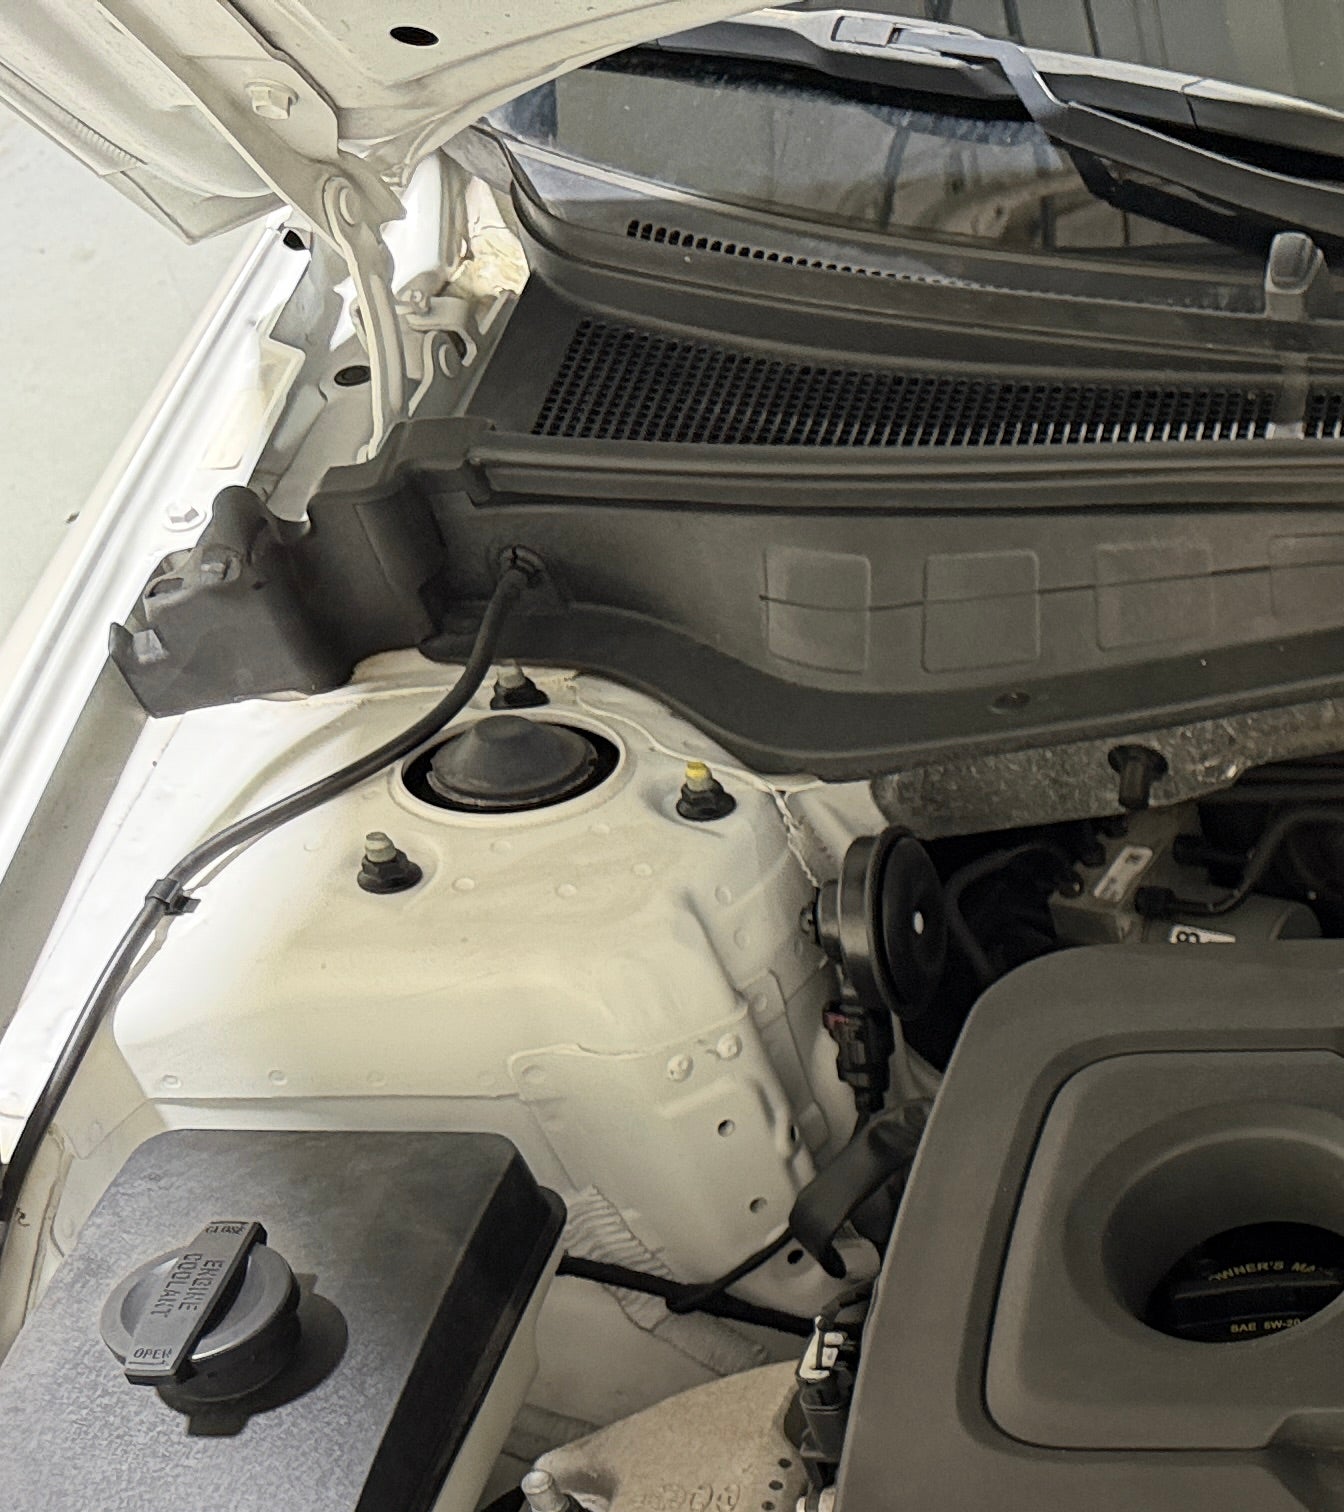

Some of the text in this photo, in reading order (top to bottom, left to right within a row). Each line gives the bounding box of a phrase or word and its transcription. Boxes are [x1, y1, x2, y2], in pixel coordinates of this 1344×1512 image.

[205, 1226, 246, 1235] CLOSE
[150, 1253, 204, 1318] COOLANT
[178, 1259, 226, 1311] ENGINE
[1230, 1322, 1257, 1334] SAE
[133, 1348, 173, 1359] OPEN
